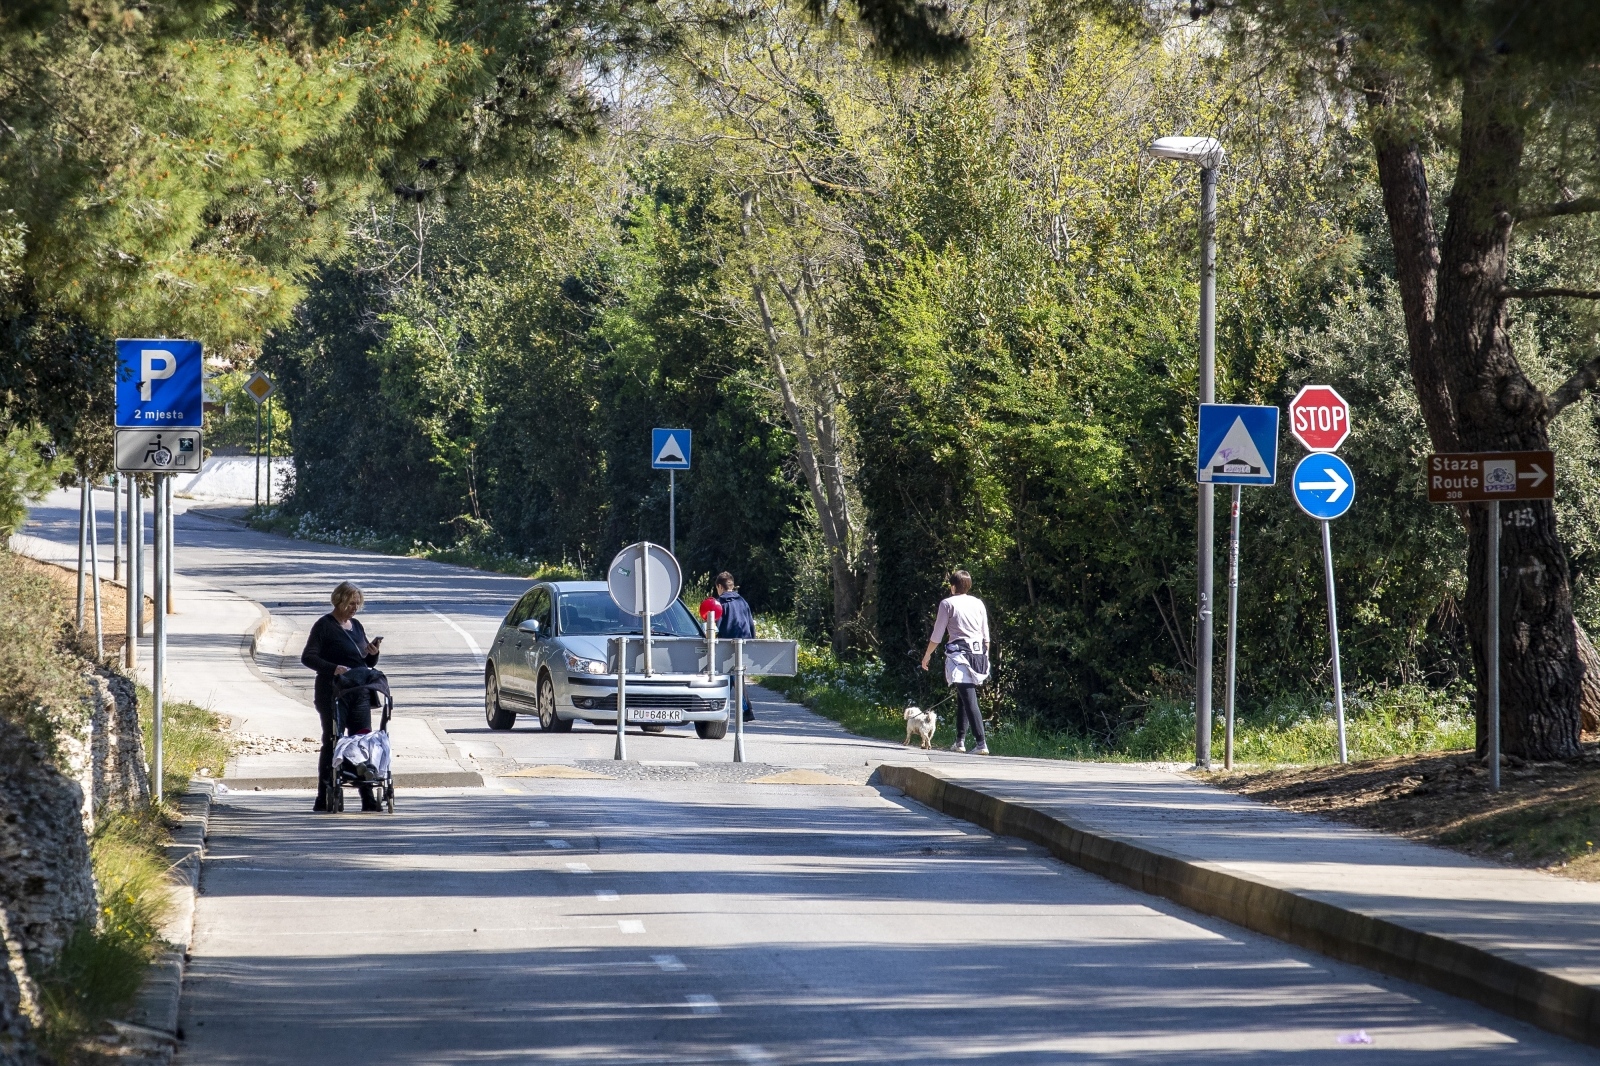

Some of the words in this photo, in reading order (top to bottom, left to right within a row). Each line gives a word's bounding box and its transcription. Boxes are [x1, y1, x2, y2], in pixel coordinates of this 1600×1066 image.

[141, 349, 177, 402] P
[134, 409, 142, 419] 2
[145, 410, 184, 421] mjesta
[1295, 405, 1345, 431] STOP
[1433, 457, 1479, 471] Staza
[1433, 475, 1479, 489] Route
[1446, 491, 1463, 499] 308
[633, 710, 645, 719] PU
